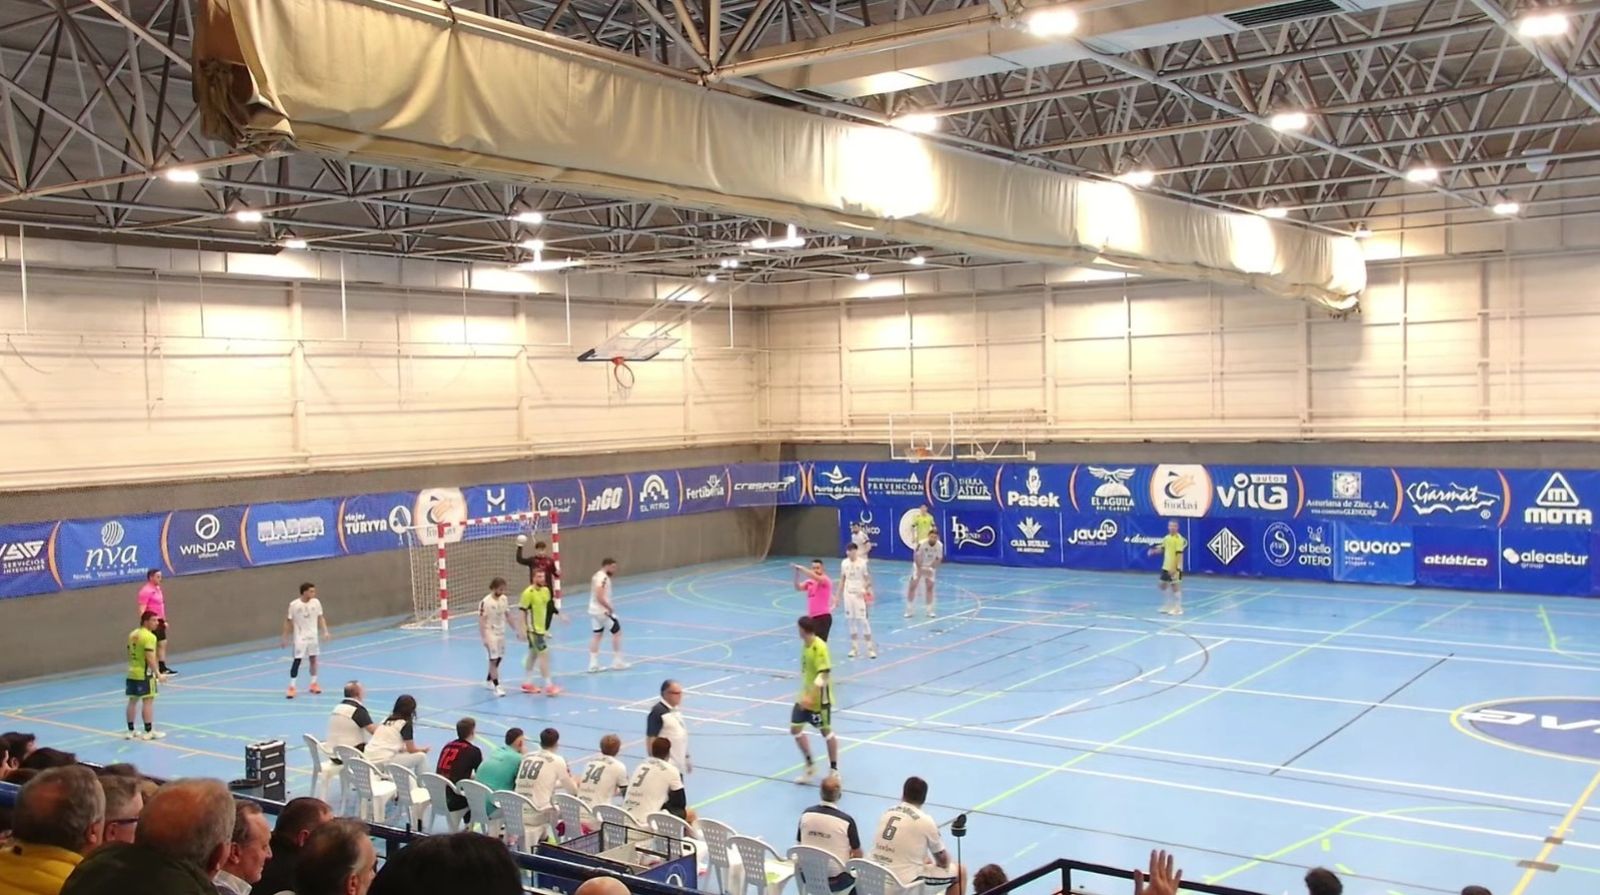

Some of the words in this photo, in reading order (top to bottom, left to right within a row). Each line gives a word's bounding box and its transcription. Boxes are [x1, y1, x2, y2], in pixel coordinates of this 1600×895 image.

[958, 486, 992, 496] ASTUR
[1007, 491, 1060, 507] Pasek
[1216, 472, 1288, 510] villa
[1091, 497, 1101, 506] EL
[345, 519, 388, 535] TURYVA
[180, 540, 236, 556] WINDAR
[1299, 544, 1307, 552] el
[1309, 545, 1331, 554] bello
[85, 544, 138, 569] nva
[1299, 556, 1331, 566] OTERO
[1521, 549, 1588, 565] aleastur
[439, 748, 459, 770] 12
[519, 759, 544, 780] 88
[582, 763, 606, 785] 34
[632, 766, 650, 788] 3
[882, 815, 902, 841] 6
